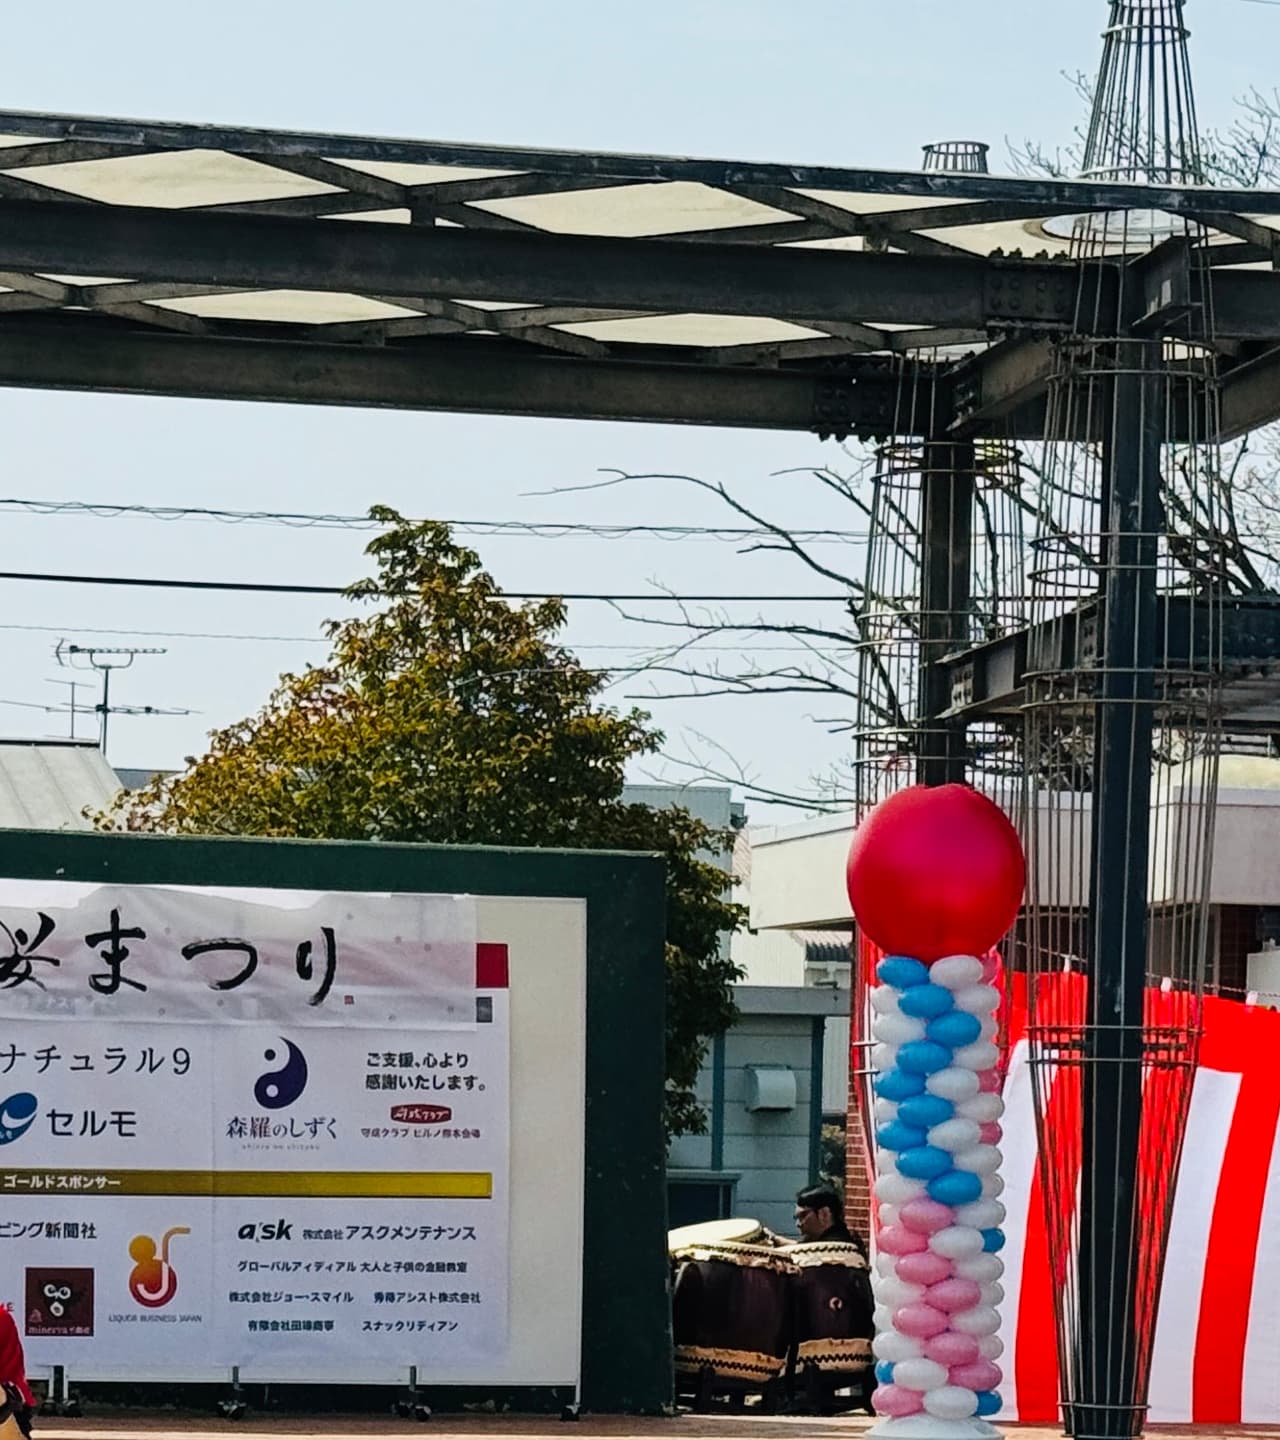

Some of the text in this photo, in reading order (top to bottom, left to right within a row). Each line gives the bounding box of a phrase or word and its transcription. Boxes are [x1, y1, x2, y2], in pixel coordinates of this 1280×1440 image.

[367, 1052, 469, 1069] ご支援、心より
[365, 1073, 486, 1091] 感謝いたします。
[46, 1108, 136, 1138] セルモ
[226, 1115, 338, 1140] 森羅のしずく
[3, 1174, 121, 1190] ゴールドスポンサー
